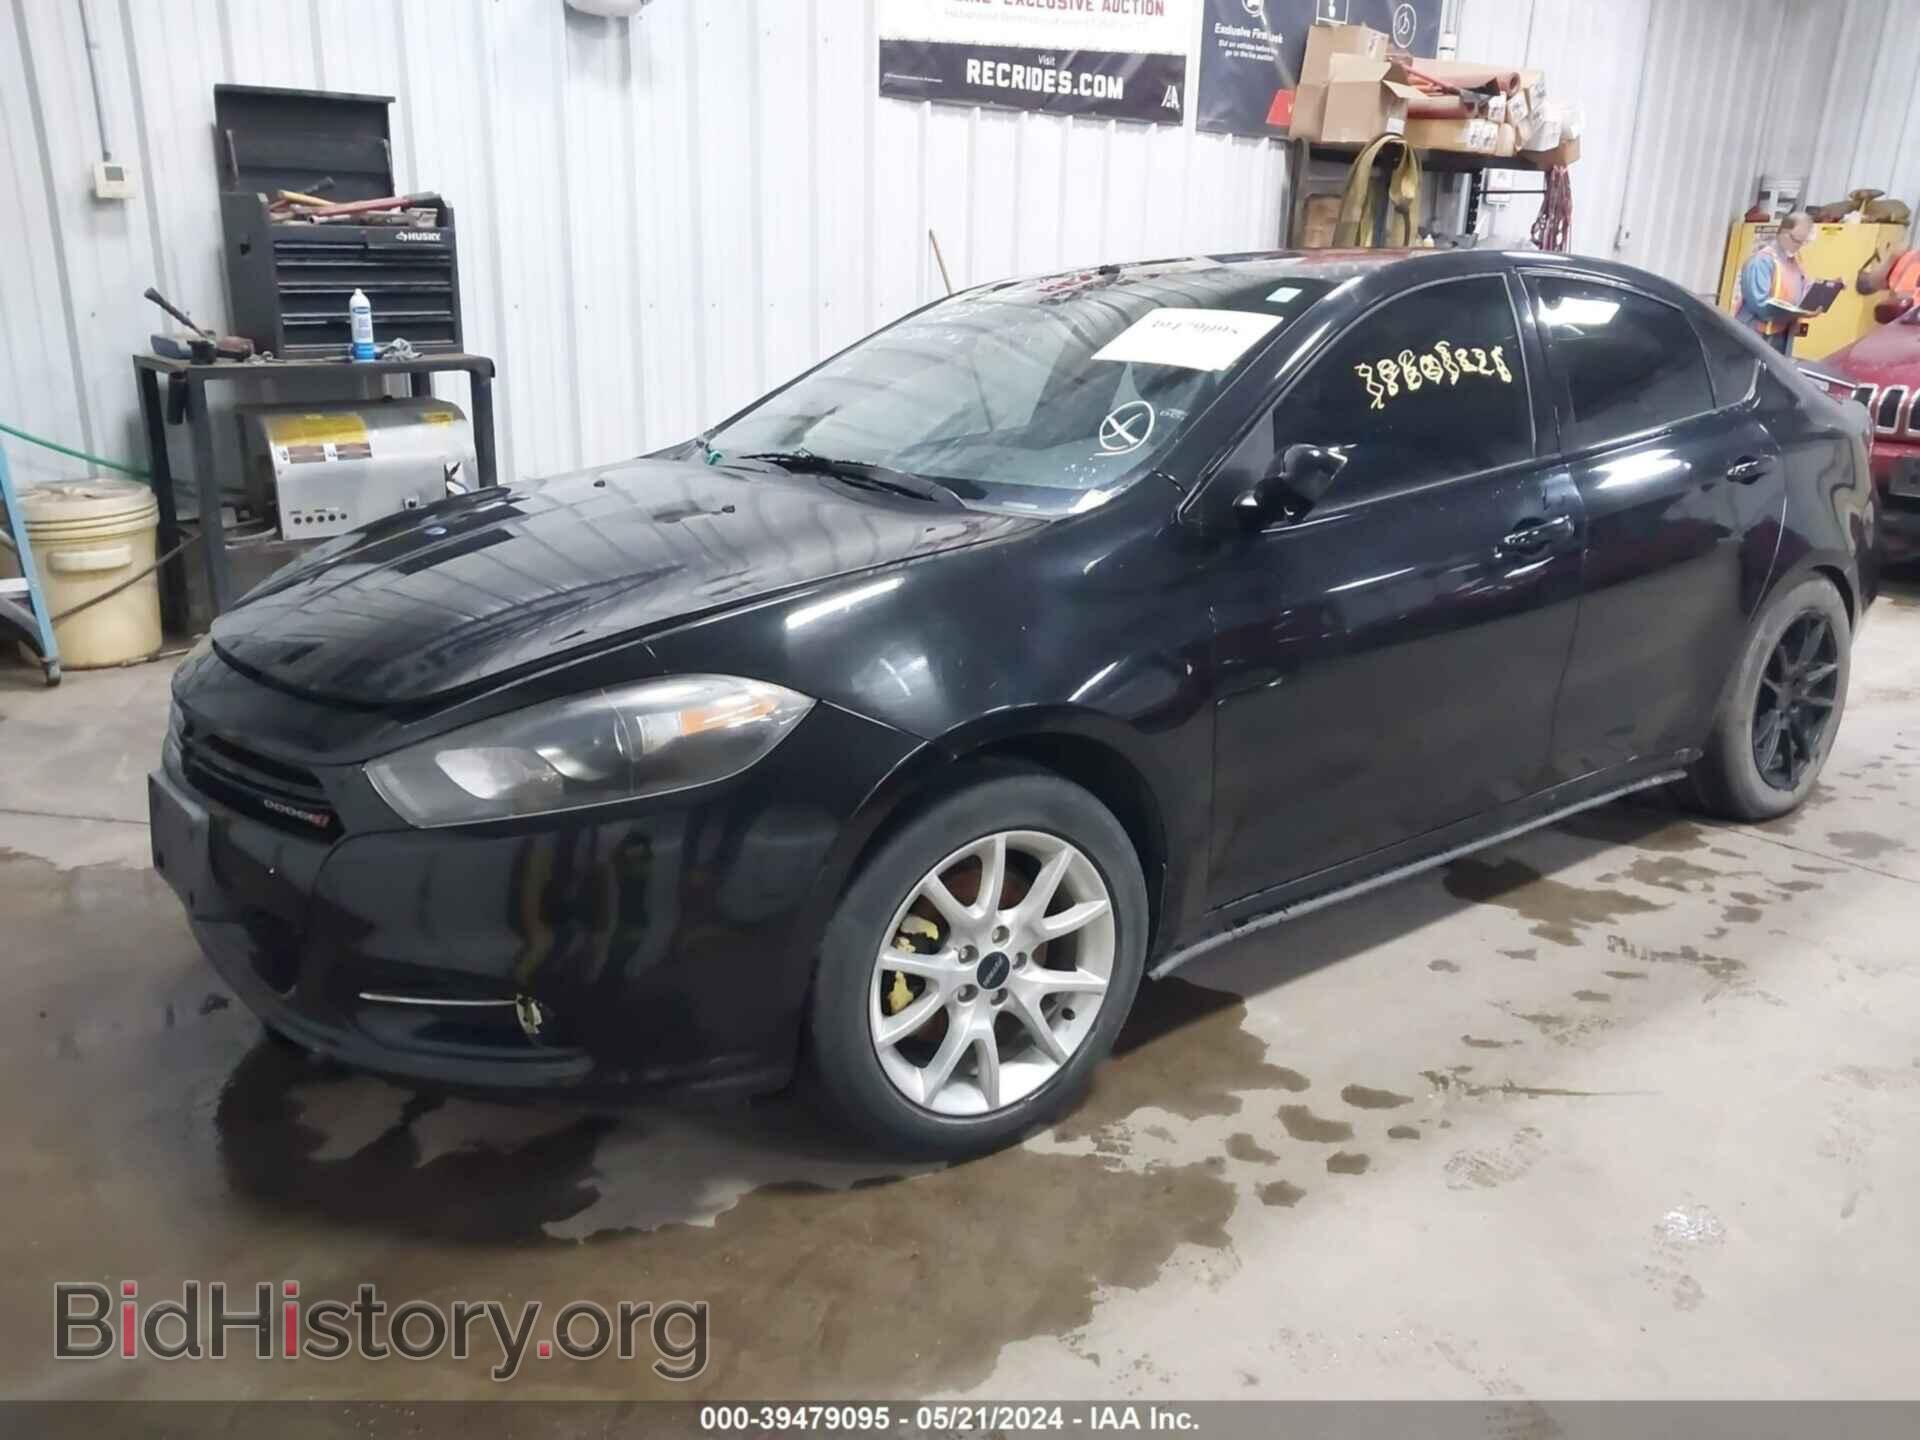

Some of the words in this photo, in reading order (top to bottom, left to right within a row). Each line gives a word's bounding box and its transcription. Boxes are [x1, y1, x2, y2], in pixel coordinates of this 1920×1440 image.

[1102, 0, 1165, 16] AUCTION
[1215, 22, 1251, 37] Exclusive
[1037, 54, 1056, 66] Visit
[966, 58, 1124, 100] RECRIDES.COM
[407, 232, 441, 241] HUSKY
